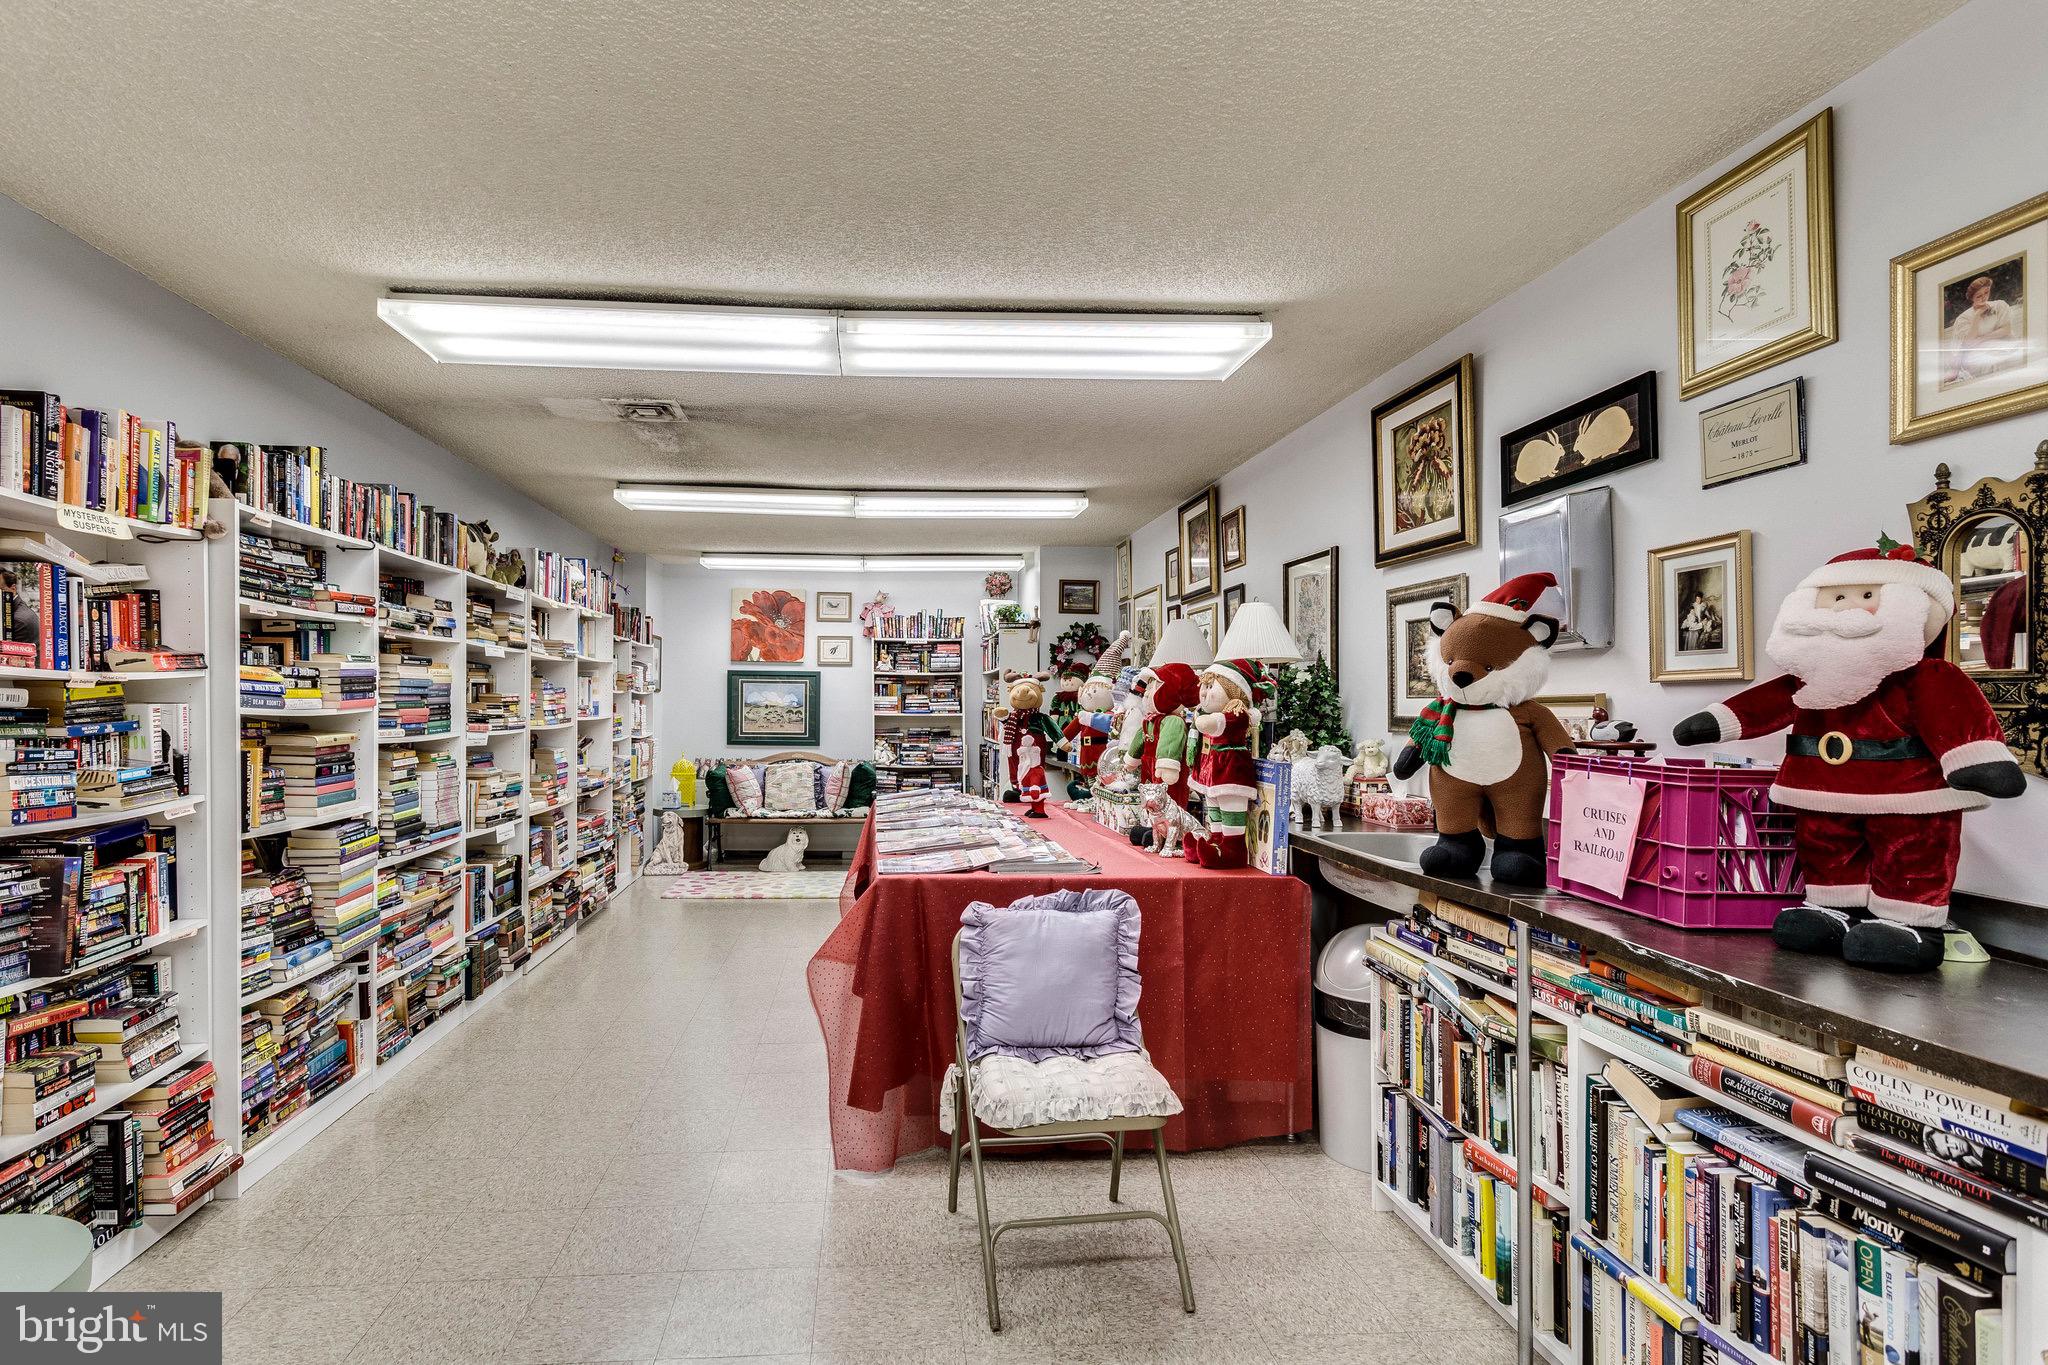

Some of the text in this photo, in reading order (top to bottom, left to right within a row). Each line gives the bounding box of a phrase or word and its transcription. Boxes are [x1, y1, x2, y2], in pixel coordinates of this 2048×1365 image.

[1731, 435, 1759, 448] MERLOT
[46, 448, 55, 480] NIGHT
[1738, 451, 1753, 460] 1875
[152, 461, 160, 504] EVANOVICH
[63, 508, 109, 524] MYSTERIES
[73, 520, 118, 536] SUSPENSE
[58, 568, 67, 594] DAVID
[266, 698, 281, 706] KOONTZ
[1583, 806, 1627, 826] CRUISES
[1594, 827, 1615, 842] AND
[1574, 840, 1625, 863] RAILROAD
[21, 882, 39, 892] MALICE
[1540, 993, 1576, 1013] LOST SON
[1627, 997, 1639, 1011] THE
[1640, 1002, 1659, 1020] SHARK
[13, 1024, 23, 1032] LISA
[23, 1016, 48, 1030] SCOTTOLINE
[1707, 1022, 1733, 1044] ERROL
[1734, 1032, 1761, 1052] FLYNN
[1724, 1077, 1789, 1113] GRAHAM GREENE
[1740, 1077, 1753, 1087] THE
[1753, 1082, 1767, 1093] LIFE
[1853, 1065, 2012, 1129] COLIN POWELL
[1857, 1090, 2010, 1155] MY AMERICAN JOURNEY
[1859, 1102, 1921, 1133] CHARLTON
[1886, 1088, 1931, 1112] Joseph
[1957, 1112, 2010, 1138] Persico
[197, 1126, 209, 1139] FURY
[1590, 1123, 1598, 1150] VALUES
[1618, 1117, 1628, 1140] David
[1860, 1112, 1920, 1145] HESTON
[1590, 1152, 1597, 1166] OF
[1619, 1141, 1629, 1185] Halberstam
[1739, 1158, 1768, 1184] MALCOLM
[1608, 1153, 1619, 1198] SUMMER
[1881, 1147, 1993, 1201] The PRICE of LOYALTY
[1609, 1199, 1618, 1211] OF
[1618, 1187, 1628, 1217] October
[1780, 1218, 1788, 1235] BILLIE
[1852, 1206, 1905, 1244] Monty
[1897, 1207, 1961, 1242] THE AUTOBIOGRAPHY
[1780, 1235, 1788, 1254] JEAN
[1579, 1246, 1608, 1273] MISTY
[1780, 1254, 1788, 1271] KING
[1860, 1245, 1875, 1289] OPEN
[1885, 1271, 1893, 1300] BLUE
[1609, 1310, 1616, 1322] UP
[1831, 1292, 1839, 1330] Mattered
[1840, 1283, 1848, 1330] When Pride
[1718, 1341, 1745, 1361] LIFETIME
